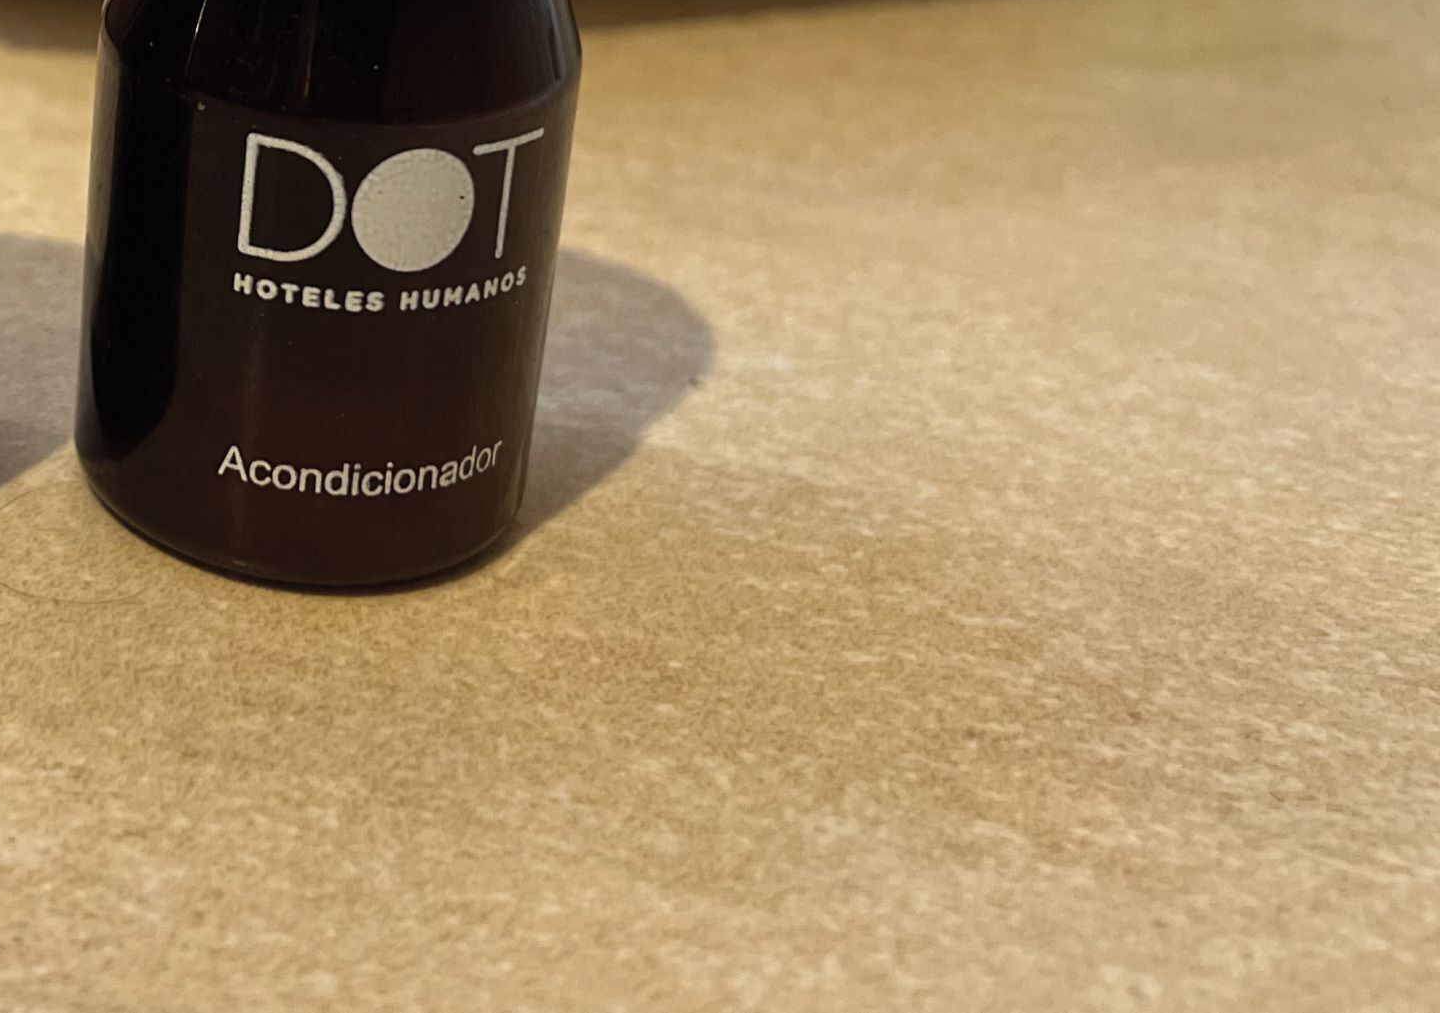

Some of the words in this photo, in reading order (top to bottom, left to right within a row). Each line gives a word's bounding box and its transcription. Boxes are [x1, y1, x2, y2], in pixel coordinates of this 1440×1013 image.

[237, 127, 545, 273] DOT
[232, 272, 386, 313] HOTELES
[399, 265, 528, 312] HUMANOS
[217, 440, 503, 497] Acondicionador
